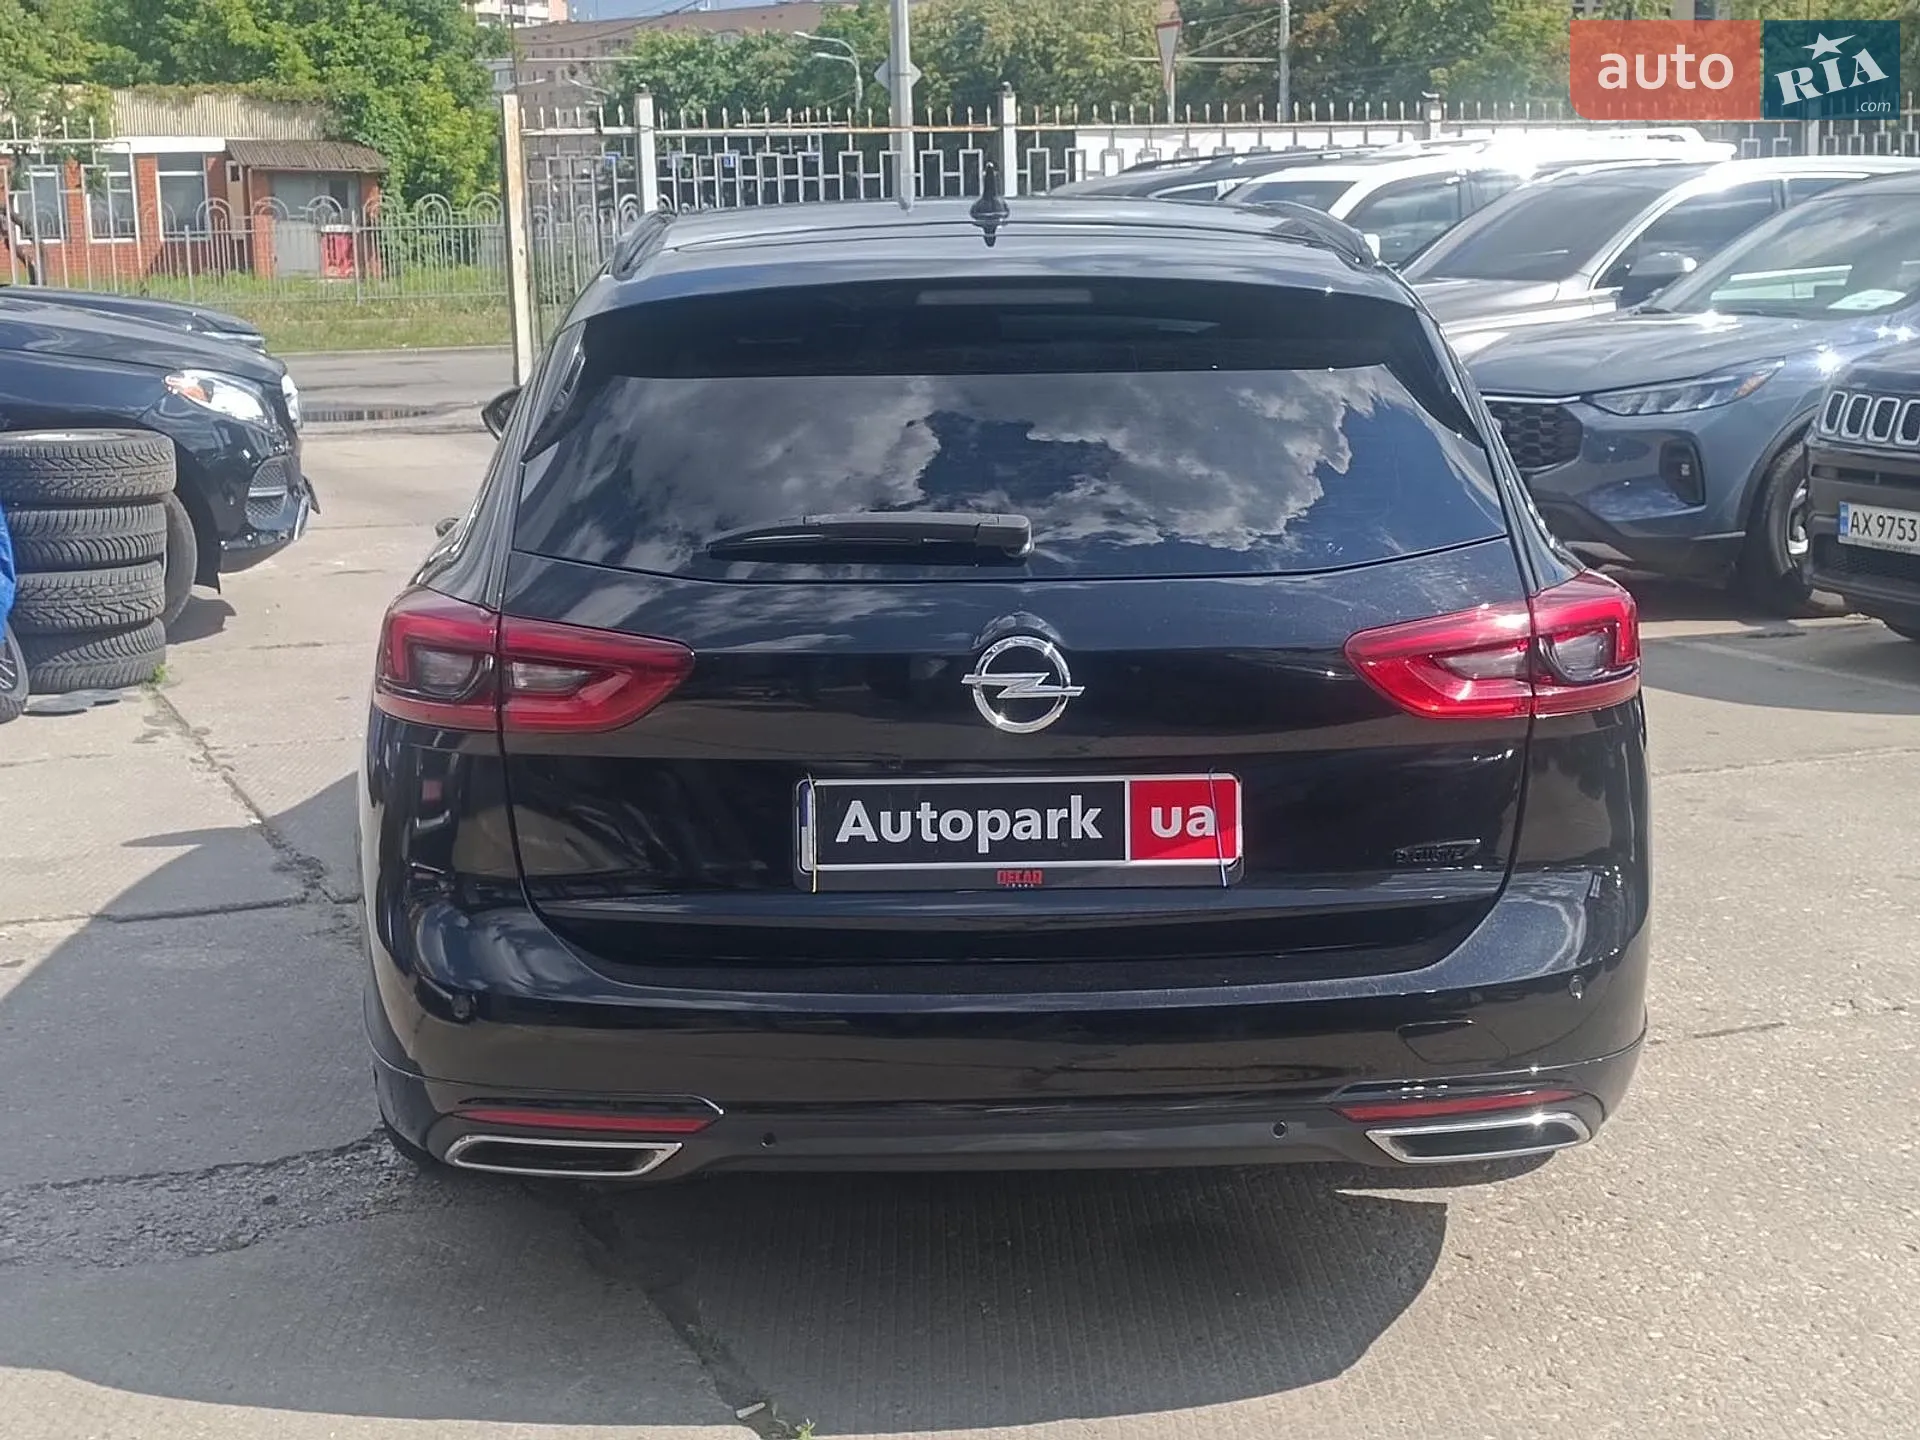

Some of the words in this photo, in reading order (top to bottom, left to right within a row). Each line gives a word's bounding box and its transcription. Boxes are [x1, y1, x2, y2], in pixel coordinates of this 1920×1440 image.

[1850, 511, 1873, 537] AX
[1876, 514, 1918, 543] 9753
[835, 795, 1103, 854] Autopark
[1150, 803, 1216, 838] ua
